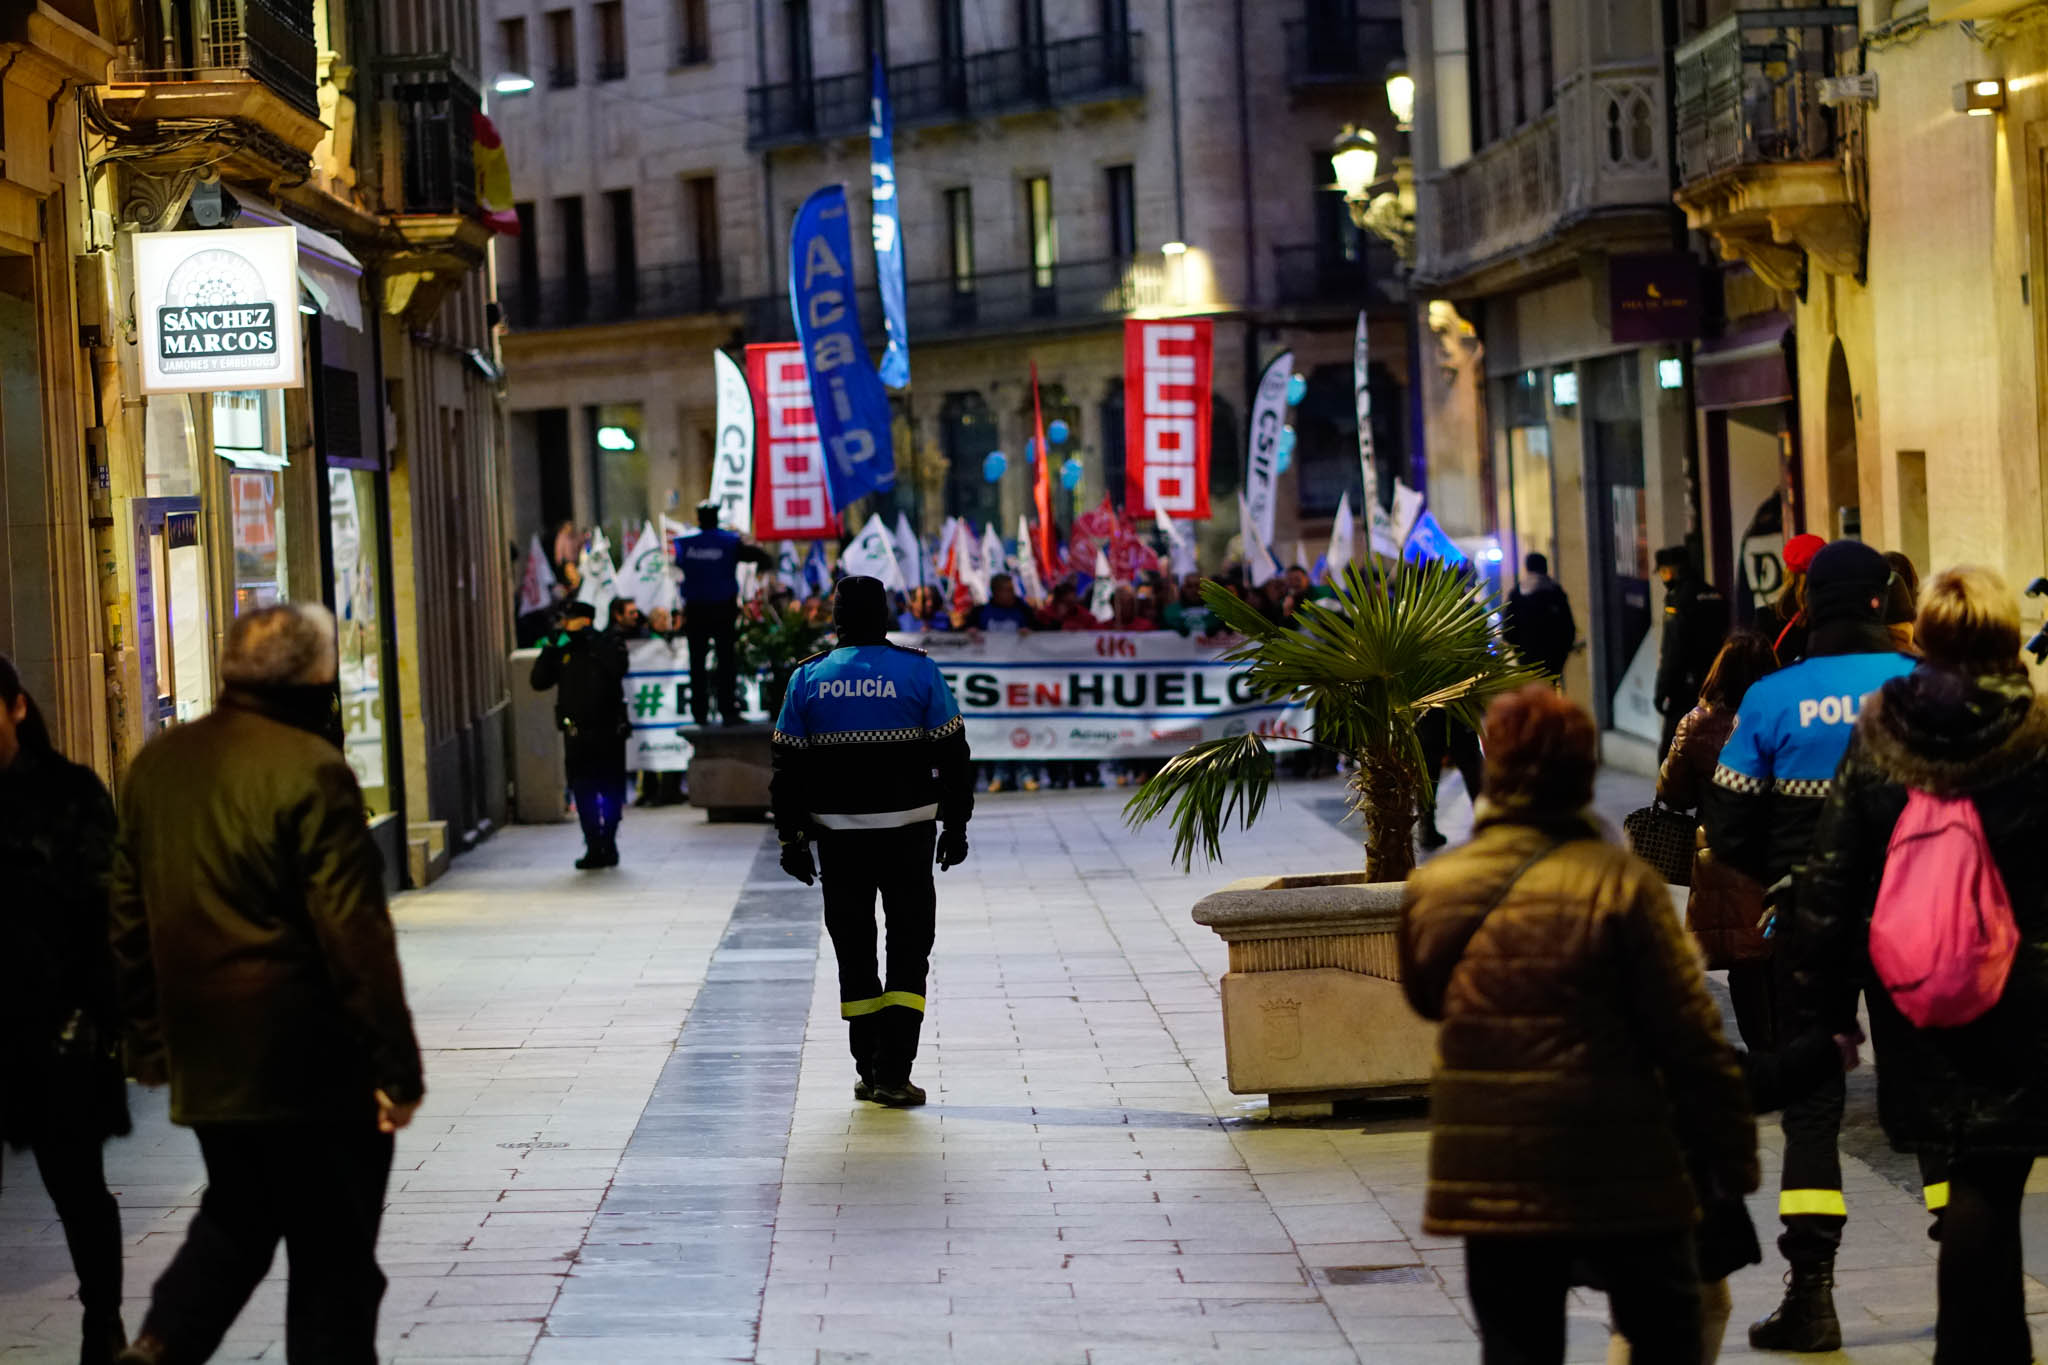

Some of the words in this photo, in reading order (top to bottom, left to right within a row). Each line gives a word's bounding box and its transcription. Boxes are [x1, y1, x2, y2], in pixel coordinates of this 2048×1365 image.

[163, 308, 271, 332] SÁNCHEZ
[163, 331, 274, 354] MARCOS
[803, 234, 876, 476] Acaip
[1252, 408, 1278, 490] CSIF
[818, 675, 898, 699] POLICÍA
[1068, 671, 1272, 708] HUELG
[1799, 695, 1866, 728] POL
